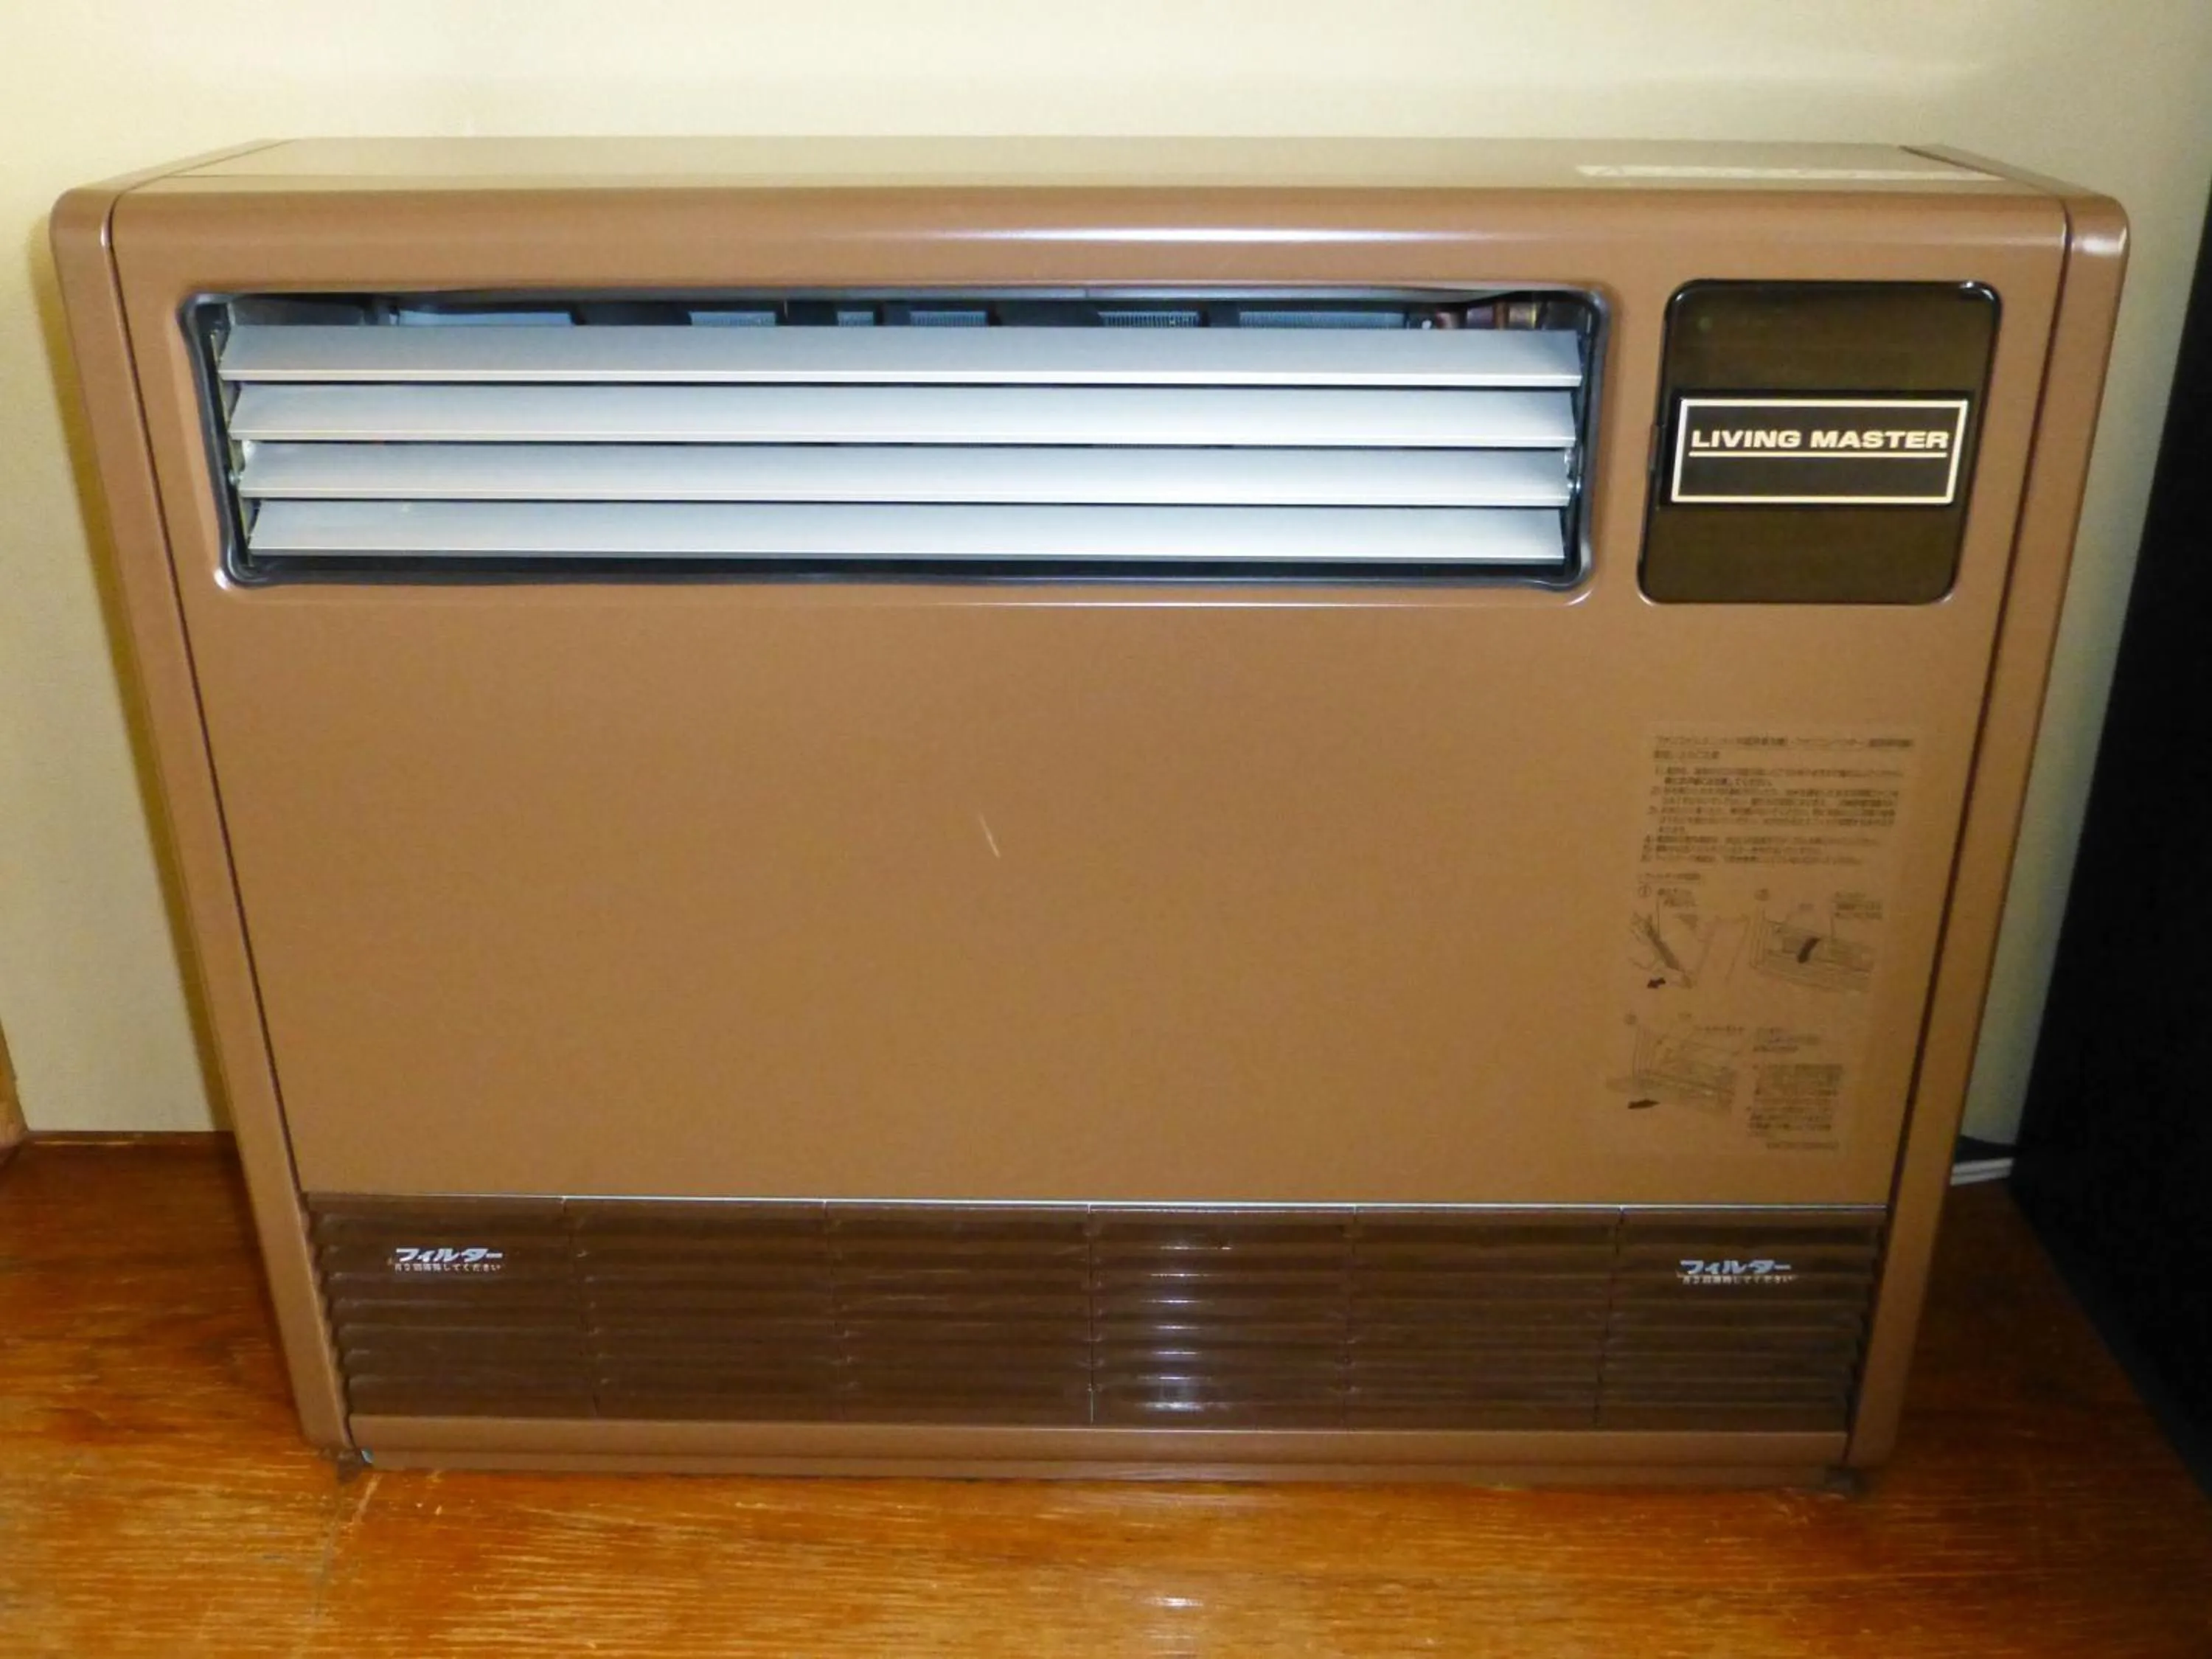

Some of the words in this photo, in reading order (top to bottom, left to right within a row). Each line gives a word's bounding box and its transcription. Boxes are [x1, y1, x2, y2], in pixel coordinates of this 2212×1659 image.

[1691, 429, 1802, 449] LIVING
[1809, 431, 1949, 450] MASTER
[395, 1248, 504, 1262] フィルター
[1680, 1260, 1792, 1275] フィルター
